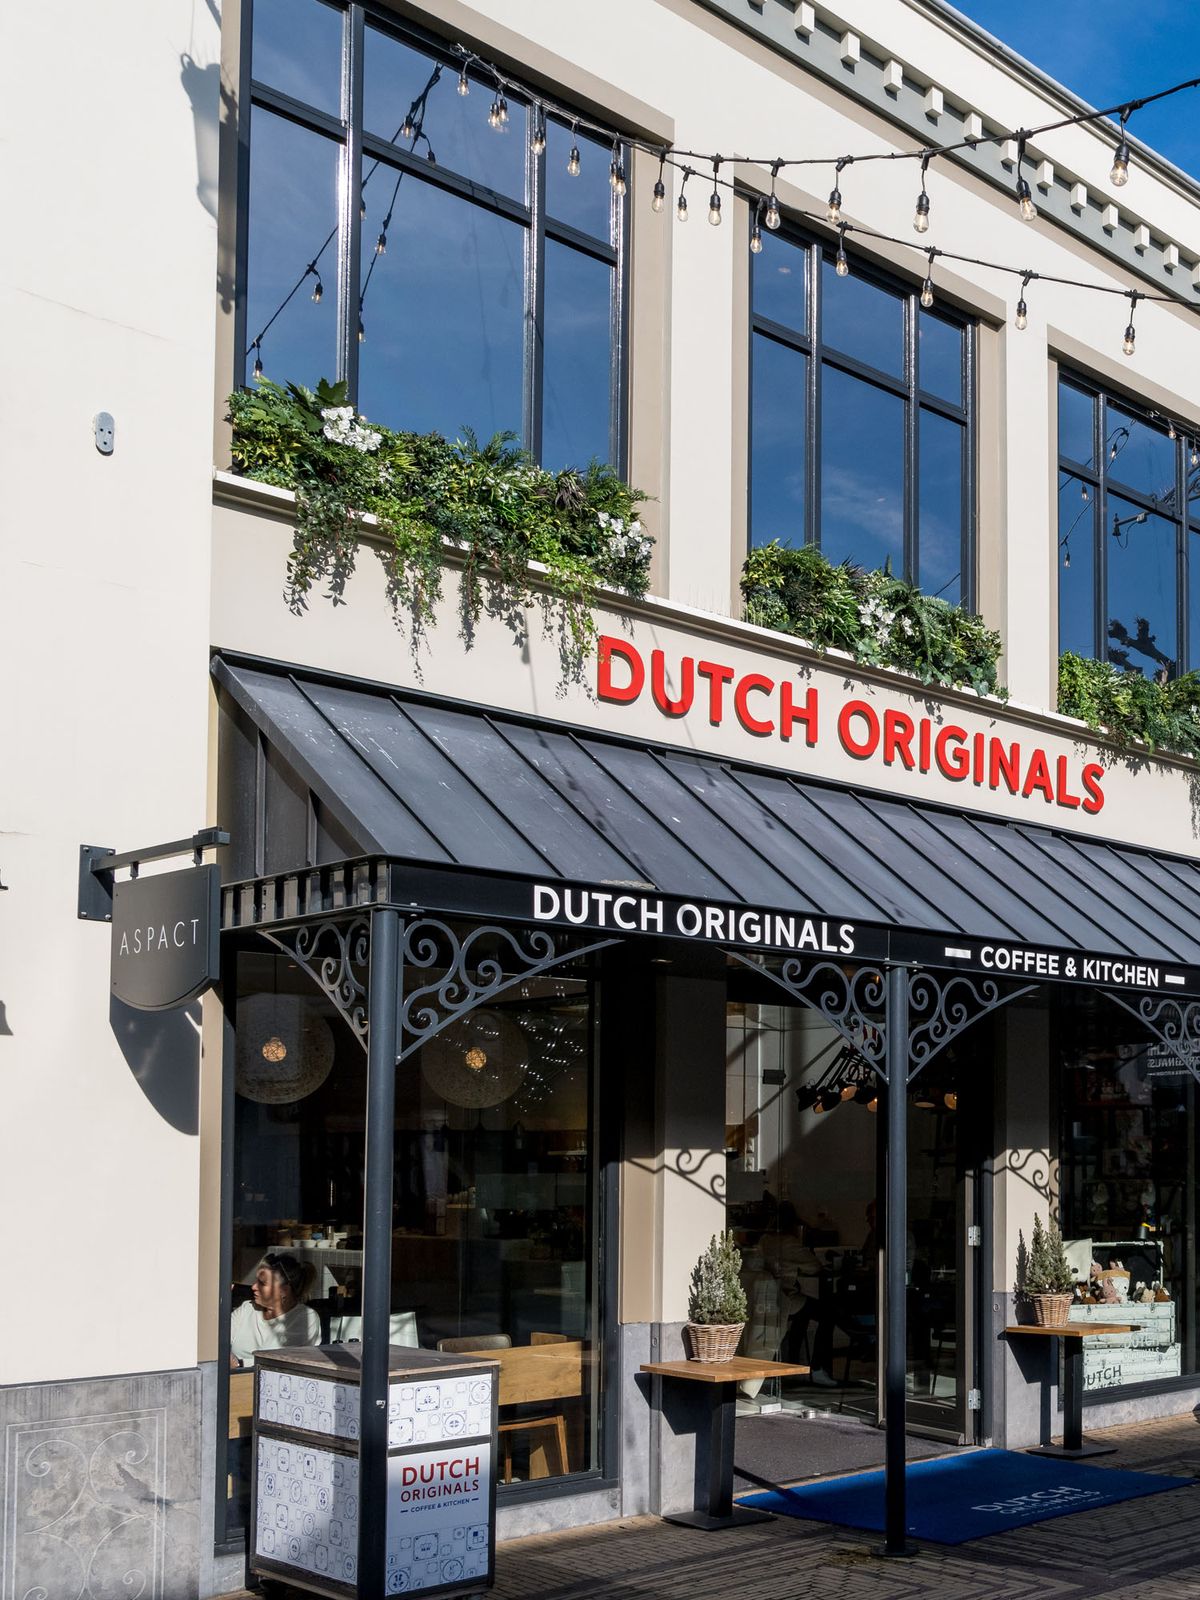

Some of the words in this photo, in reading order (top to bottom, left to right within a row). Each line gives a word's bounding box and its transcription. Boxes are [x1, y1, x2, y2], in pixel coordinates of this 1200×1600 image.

[598, 635, 818, 747] DUTCH
[838, 699, 1105, 813] ORIGINALS
[534, 885, 663, 933] DUTCH
[676, 903, 855, 954] ORIGINALS
[119, 919, 199, 956] ASPACT
[980, 946, 1060, 975] COFFEE
[1065, 957, 1077, 977] &
[1083, 959, 1159, 987] KITCHEN
[402, 1456, 480, 1487] DUTCH
[400, 1479, 479, 1503] ORIGINALS
[411, 1503, 435, 1513] COFFEE
[443, 1498, 470, 1508] KITCHEN
[971, 1486, 1082, 1511] DUTCH
